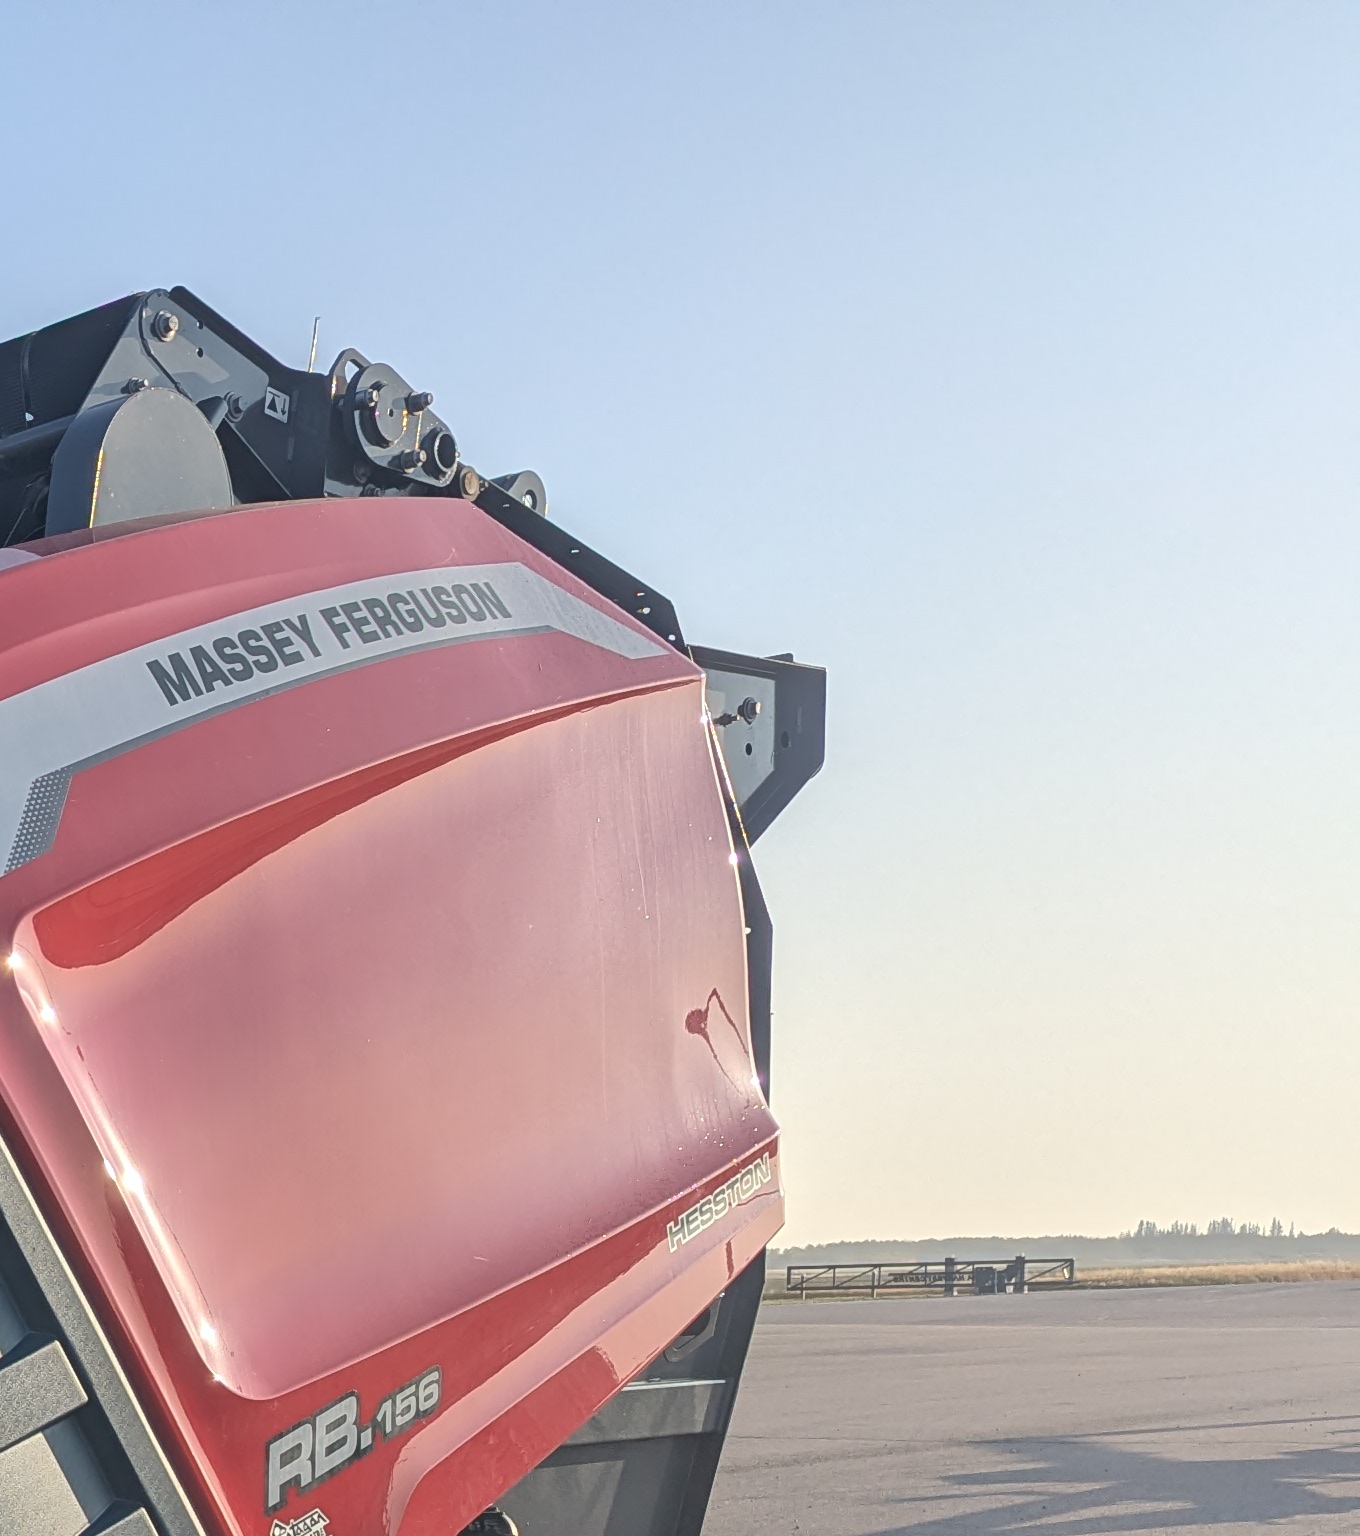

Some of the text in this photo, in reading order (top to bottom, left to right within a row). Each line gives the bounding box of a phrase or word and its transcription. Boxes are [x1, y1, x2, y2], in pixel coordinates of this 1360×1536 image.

[145, 582, 512, 706] MASSEY FERGUSON
[666, 1152, 772, 1253] HESSTON
